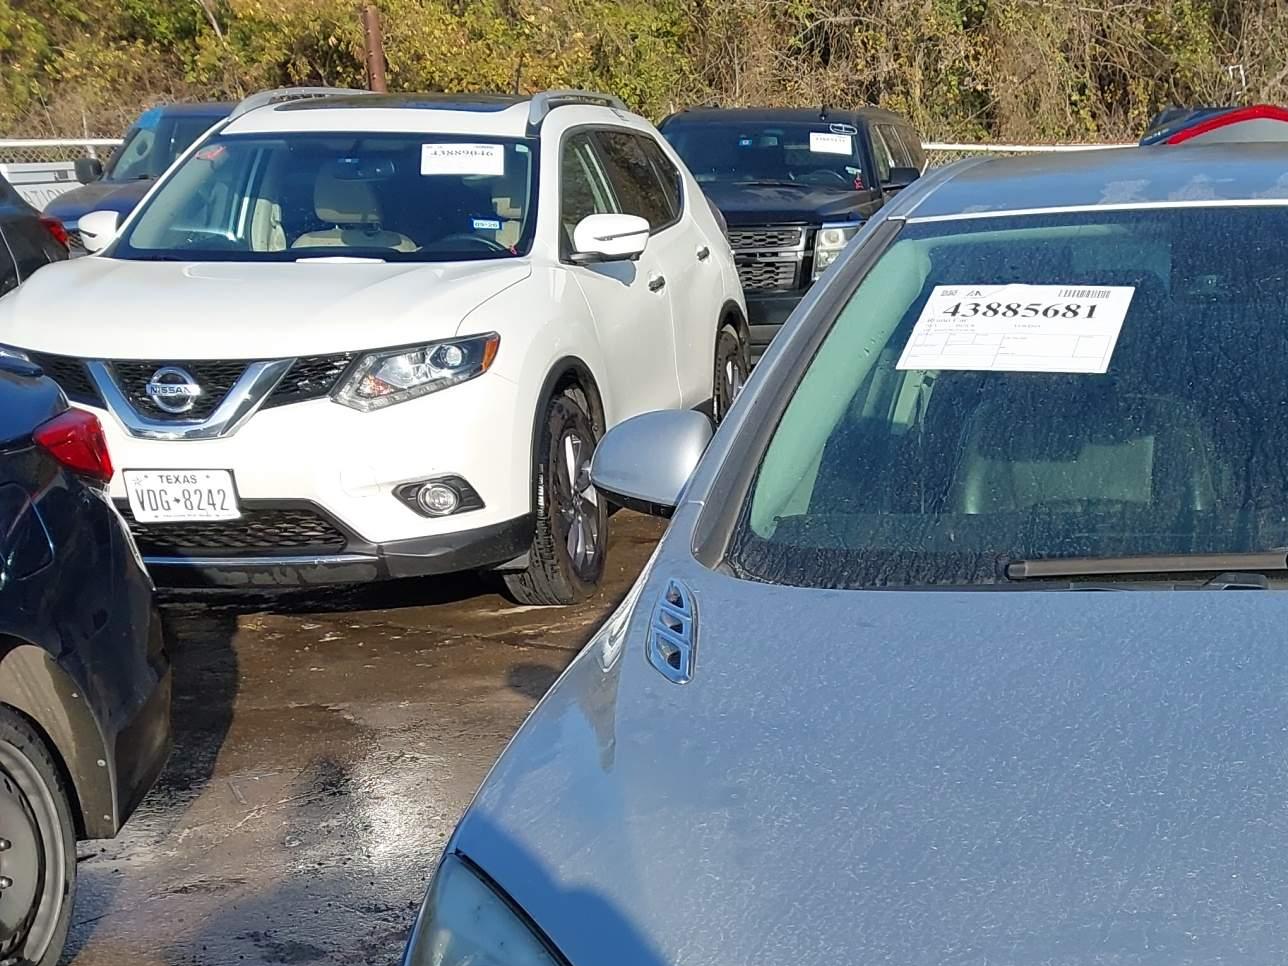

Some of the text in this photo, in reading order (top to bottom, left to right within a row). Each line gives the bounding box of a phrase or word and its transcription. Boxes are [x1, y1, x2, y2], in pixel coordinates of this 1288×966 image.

[942, 301, 1098, 319] 43885681
[150, 386, 192, 395] NISSAN
[157, 474, 198, 485] TEXAS
